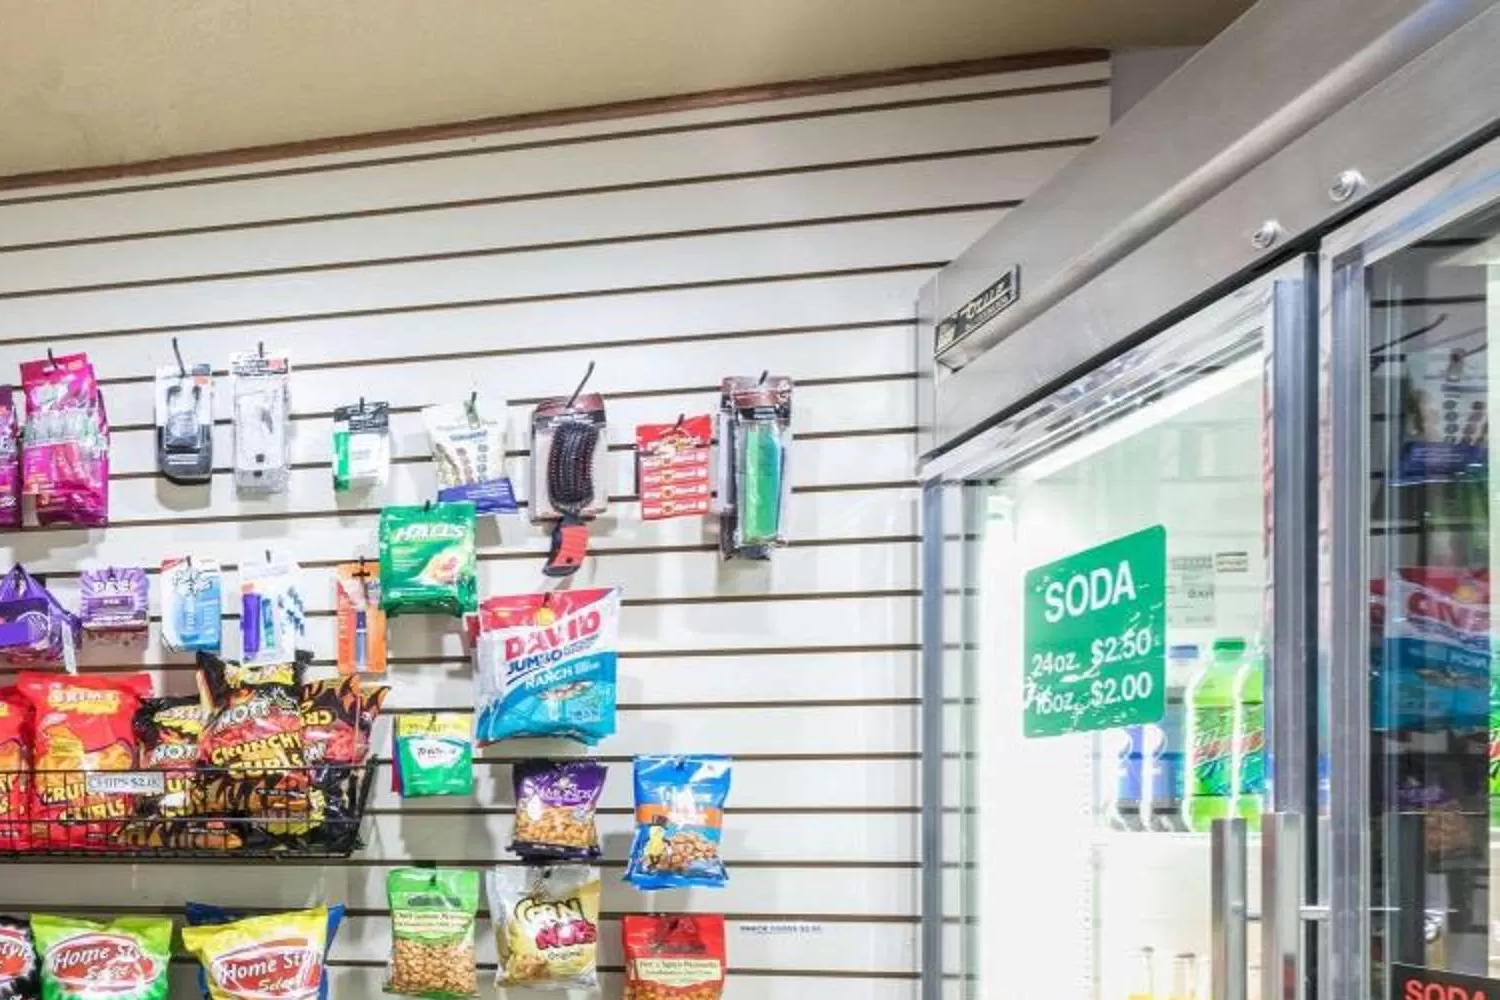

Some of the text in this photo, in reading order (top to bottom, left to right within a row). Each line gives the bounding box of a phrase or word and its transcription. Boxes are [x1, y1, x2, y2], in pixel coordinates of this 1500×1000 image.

[1044, 560, 1137, 623] SODA
[505, 610, 601, 661] DAVID
[1091, 628, 1153, 666] $2.50
[1091, 671, 1153, 707] $2.00
[212, 732, 301, 766] CRUNCHY
[58, 799, 126, 825] CURLS
[54, 944, 109, 971] Home
[221, 956, 277, 984] Home
